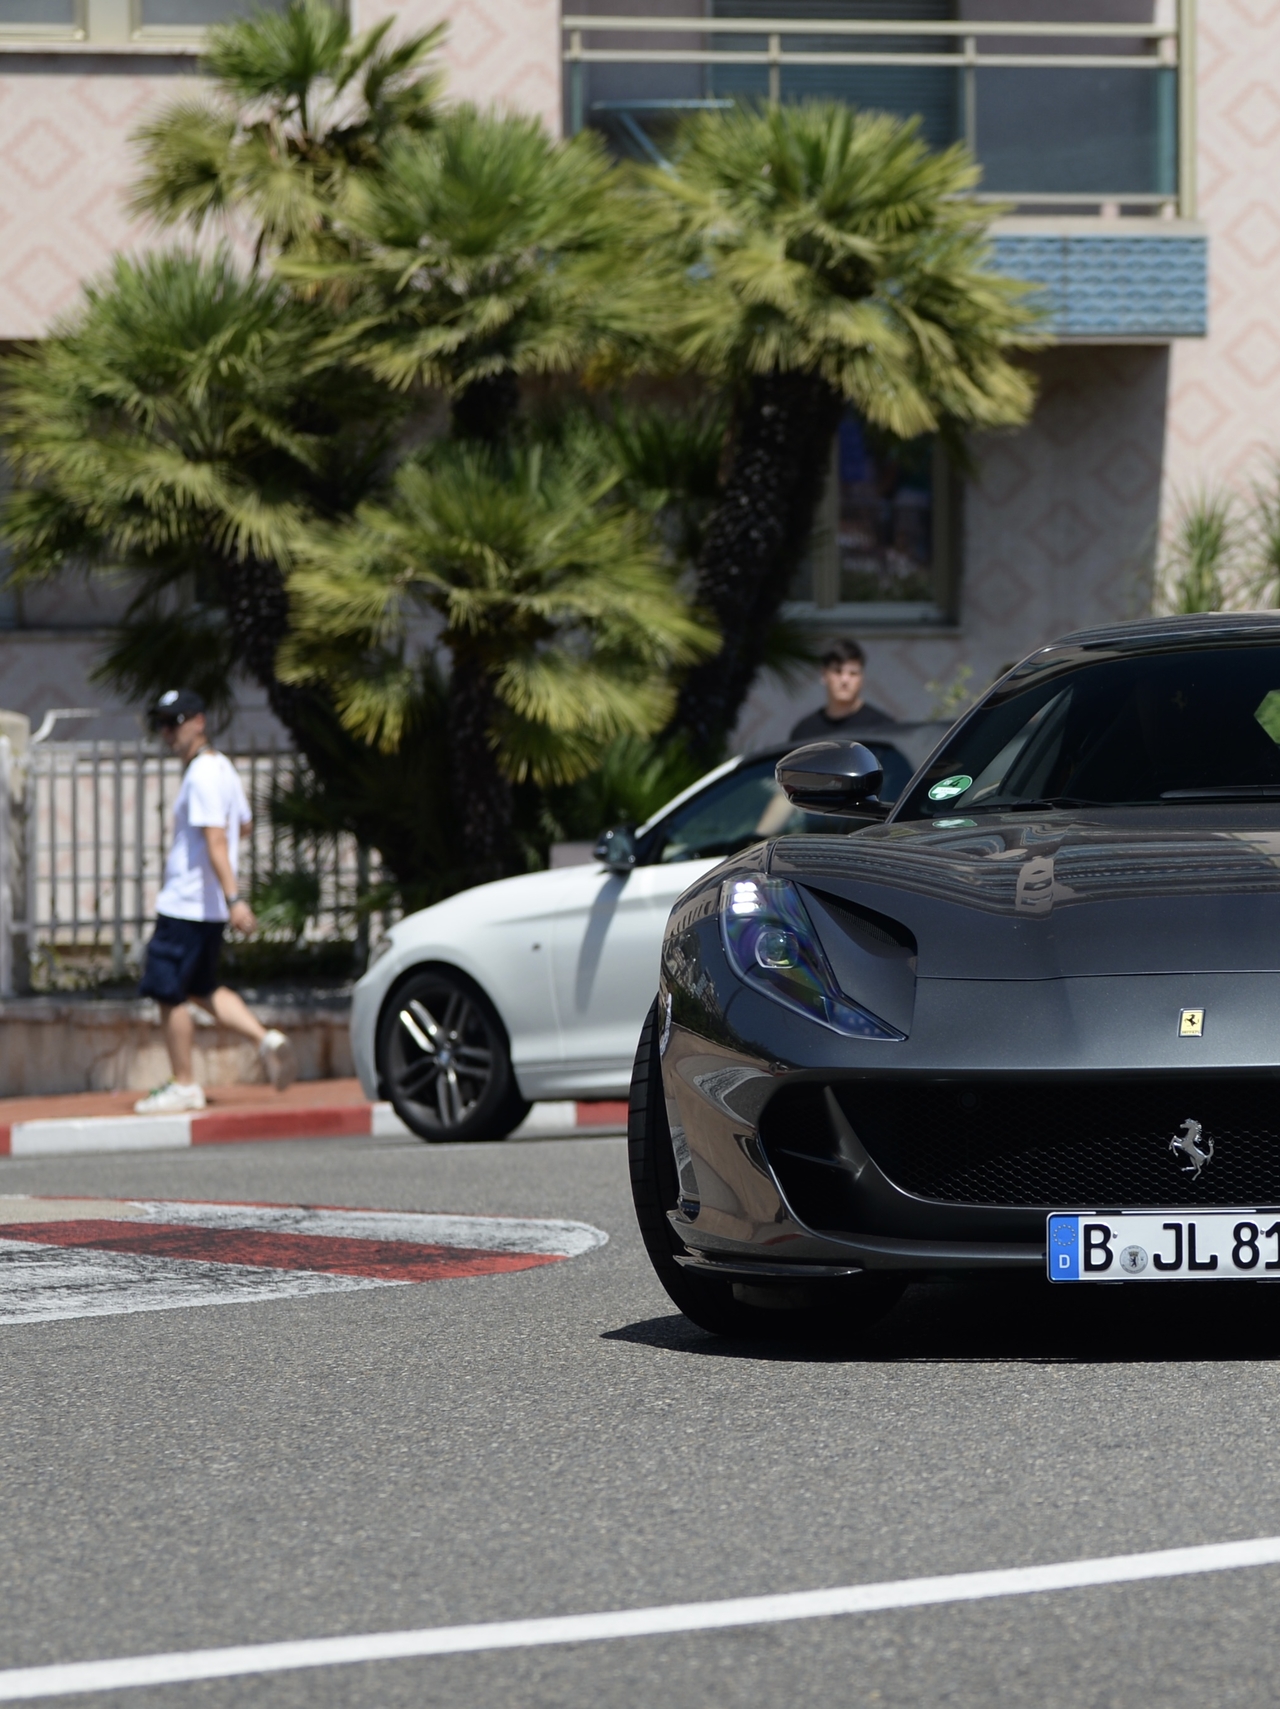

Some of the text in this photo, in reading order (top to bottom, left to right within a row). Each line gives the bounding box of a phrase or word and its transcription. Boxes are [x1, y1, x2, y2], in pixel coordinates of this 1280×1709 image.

[1058, 1254, 1070, 1269] D
[1083, 1223, 1114, 1272] B
[1153, 1222, 1218, 1271] JL
